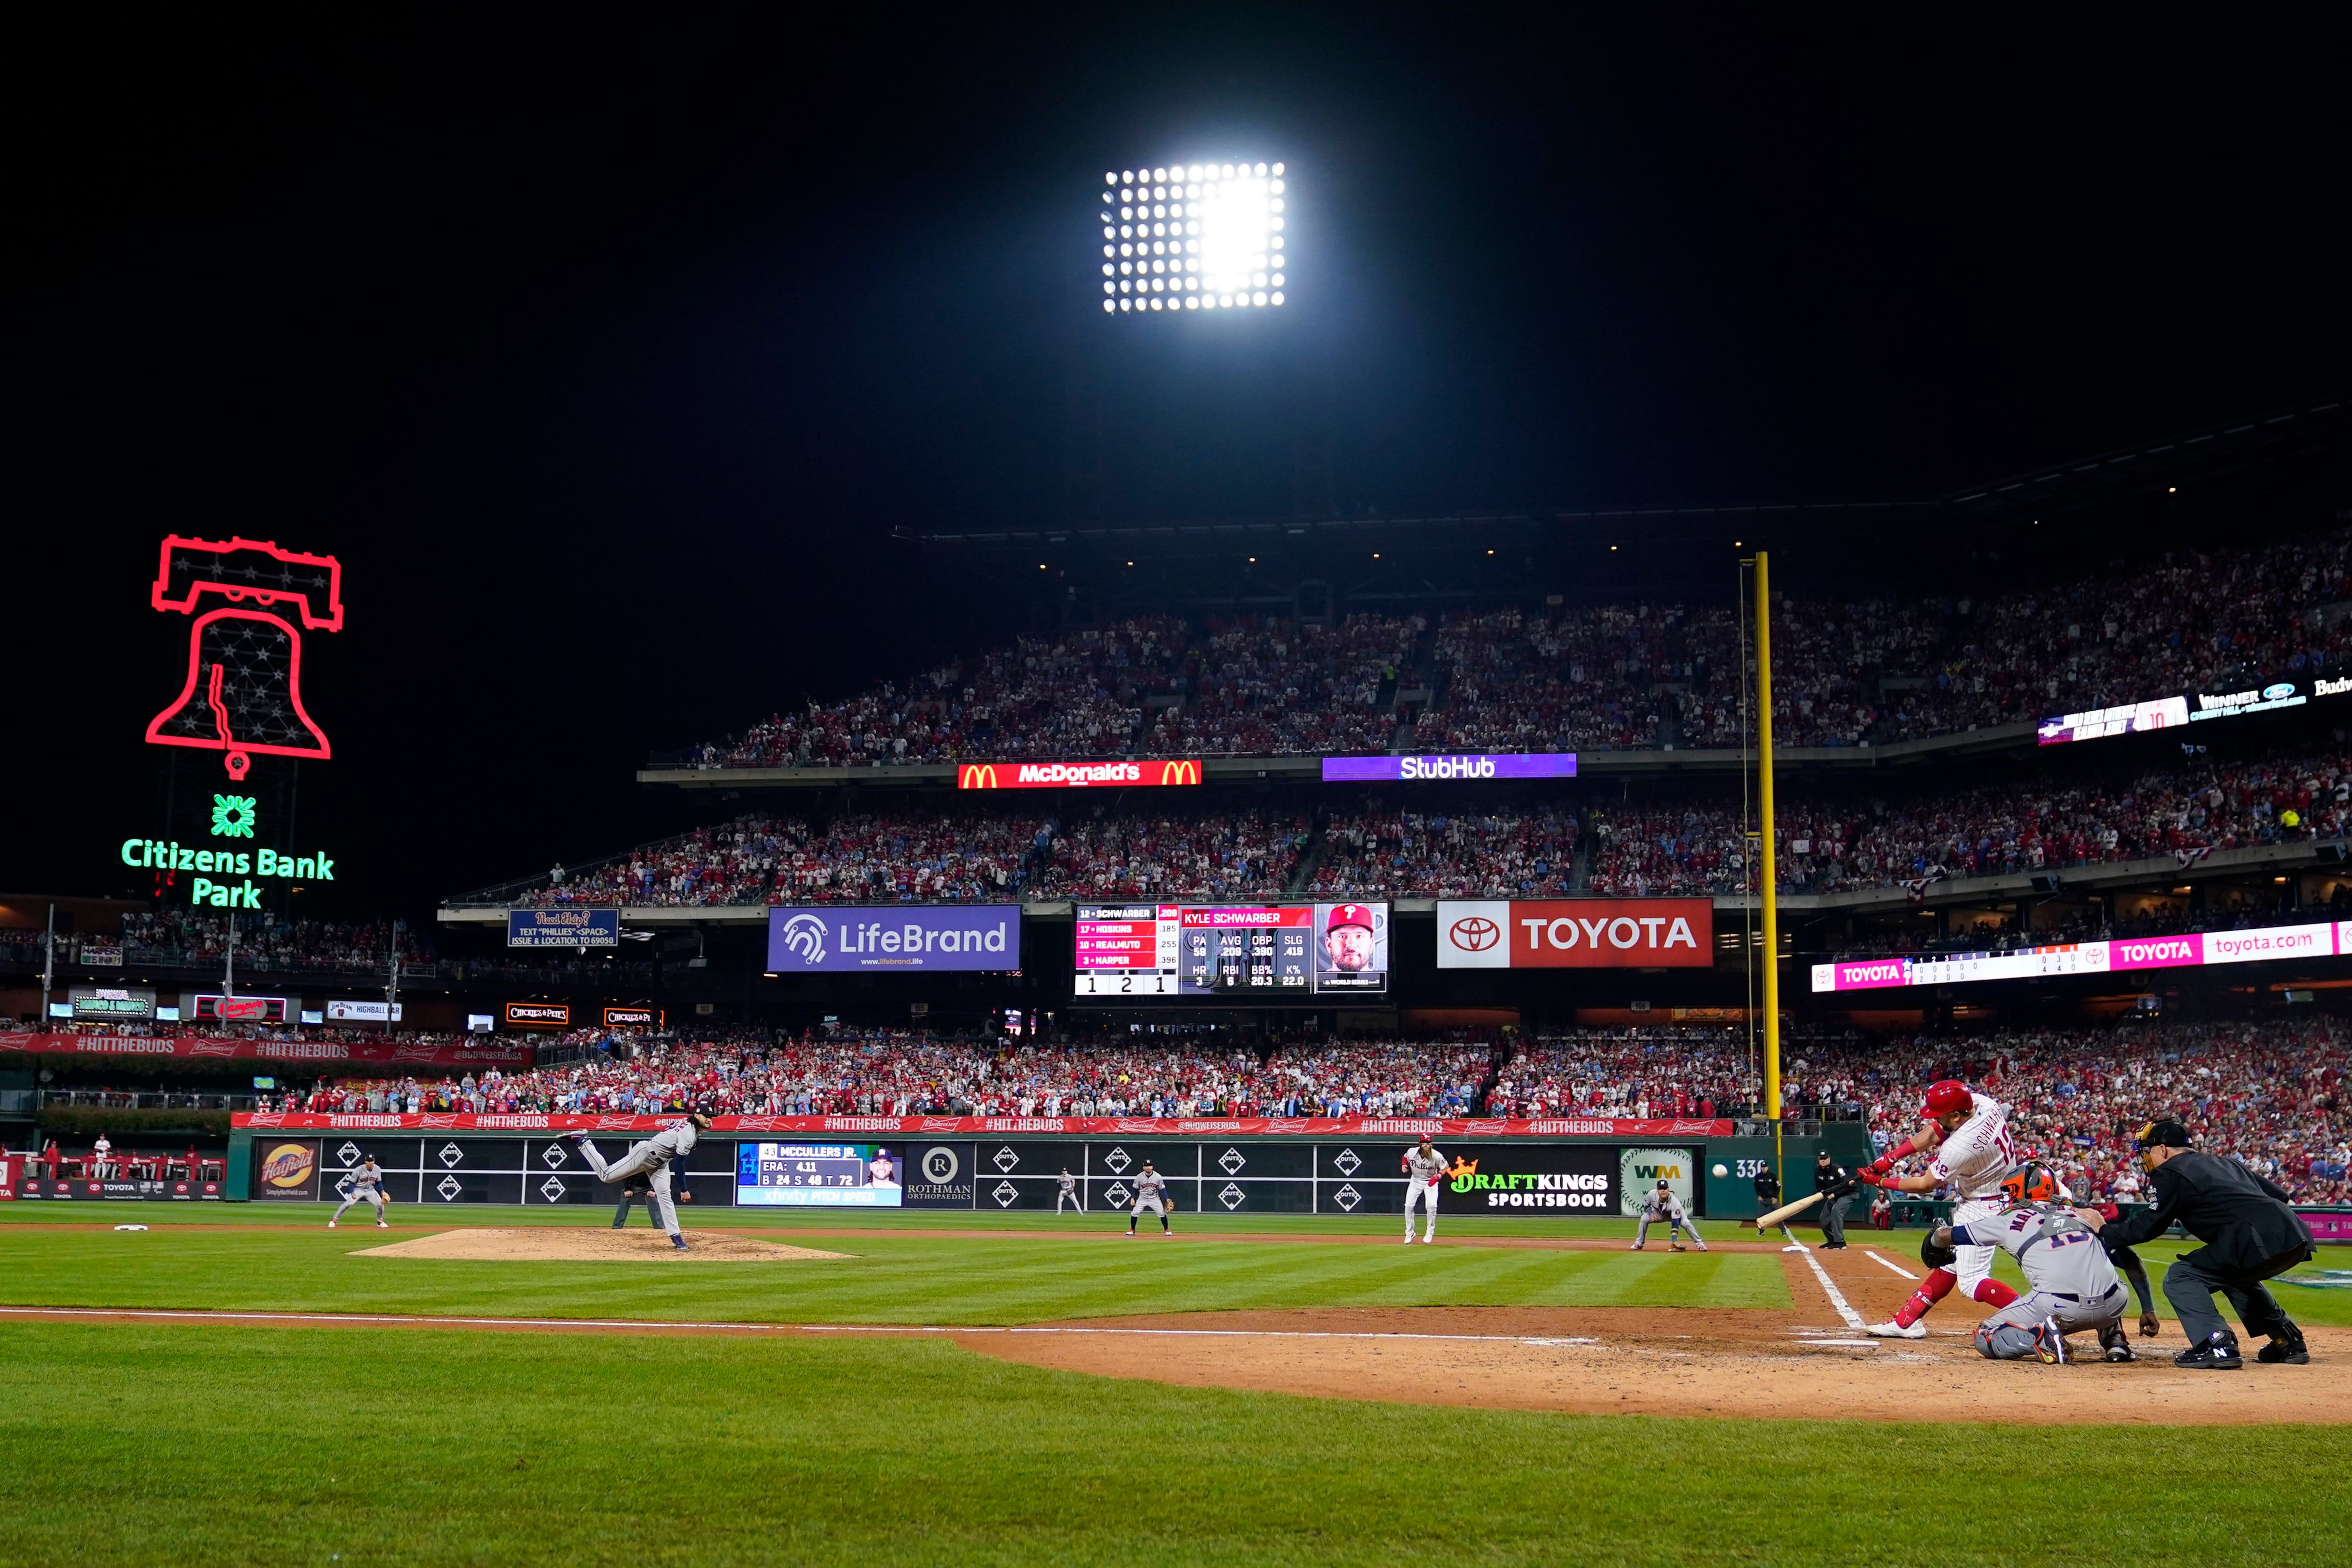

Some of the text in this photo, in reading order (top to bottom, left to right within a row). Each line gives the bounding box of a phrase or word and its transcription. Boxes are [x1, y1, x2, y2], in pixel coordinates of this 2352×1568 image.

[2199, 690, 2259, 710] WINNER
[2150, 713, 2164, 729] 10
[1019, 763, 1140, 783] McDonald's
[1400, 756, 1495, 779] StubHub
[121, 839, 334, 880] Citizens Bank
[192, 878, 261, 909] Park
[536, 911, 590, 927] Need Help?
[1097, 909, 1150, 918] SCHWARBER
[1184, 913, 1280, 924] KYLE SCHWARBER
[1097, 925, 1132, 934] HOSKINS
[1521, 917, 1697, 950] TOYOTA
[840, 922, 1006, 953] LifeBrand
[1193, 935, 1303, 945] PA AVG OBP SLG
[2121, 933, 2312, 962] TOYOTA toyota.com
[1193, 965, 1301, 975] HR RBI BB% K%
[1843, 965, 1899, 983] TOYOTA
[1089, 977, 1165, 992] 1 2 1
[1196, 976, 1304, 986] 3 6 20.3 22.0
[340, 1002, 352, 1011] BEAM
[357, 1006, 386, 1014] HIGHBALL
[510, 1007, 542, 1018] CHICKIE'S
[547, 1009, 566, 1020] PETE'S
[608, 1012, 639, 1023] CHICKIE'S
[76, 1037, 175, 1053] #HITTHEBUDS
[196, 1040, 235, 1052] Budweiser
[255, 1042, 349, 1059] #HITTHEBUDS
[454, 1050, 522, 1060] @BUDWEISERUSA
[251, 1116, 283, 1125] Budweiser
[330, 1115, 401, 1127] #HITTHEBUDS
[423, 1116, 454, 1126] Budweiser
[476, 1116, 548, 1128] #HITTHEBUDS
[600, 1117, 631, 1126] Budweiser
[741, 1119, 773, 1129] Budweiser
[824, 1117, 901, 1130] #HITTHEBUDS
[924, 1119, 958, 1129] Budweiser
[1120, 1120, 1154, 1131] Budweiser
[1178, 1121, 1240, 1130] @BUDWEISERUSA
[1270, 1120, 1305, 1131] Budweiser
[1361, 1120, 1443, 1132] #HITTHEBUDS
[1469, 1121, 1504, 1131] Budweiser
[1530, 1120, 1613, 1134] #HITTHEBUDS
[1674, 1122, 1711, 1132] Budweiser
[764, 1147, 857, 1159] 43 MCCULLERS JR.
[262, 1148, 315, 1182] Hatfield
[763, 1162, 817, 1172] ERA: 4.11
[933, 1158, 947, 1172] R
[1634, 1165, 1681, 1179] WM
[762, 1175, 853, 1186] B 24 S 48 T 72
[1450, 1173, 1608, 1193] DRAFTKINGS
[907, 1184, 971, 1194] ROTHMAN
[764, 1188, 876, 1204] xfinity PITCH SPEED
[1488, 1193, 1607, 1208] SPORTSBOOK
